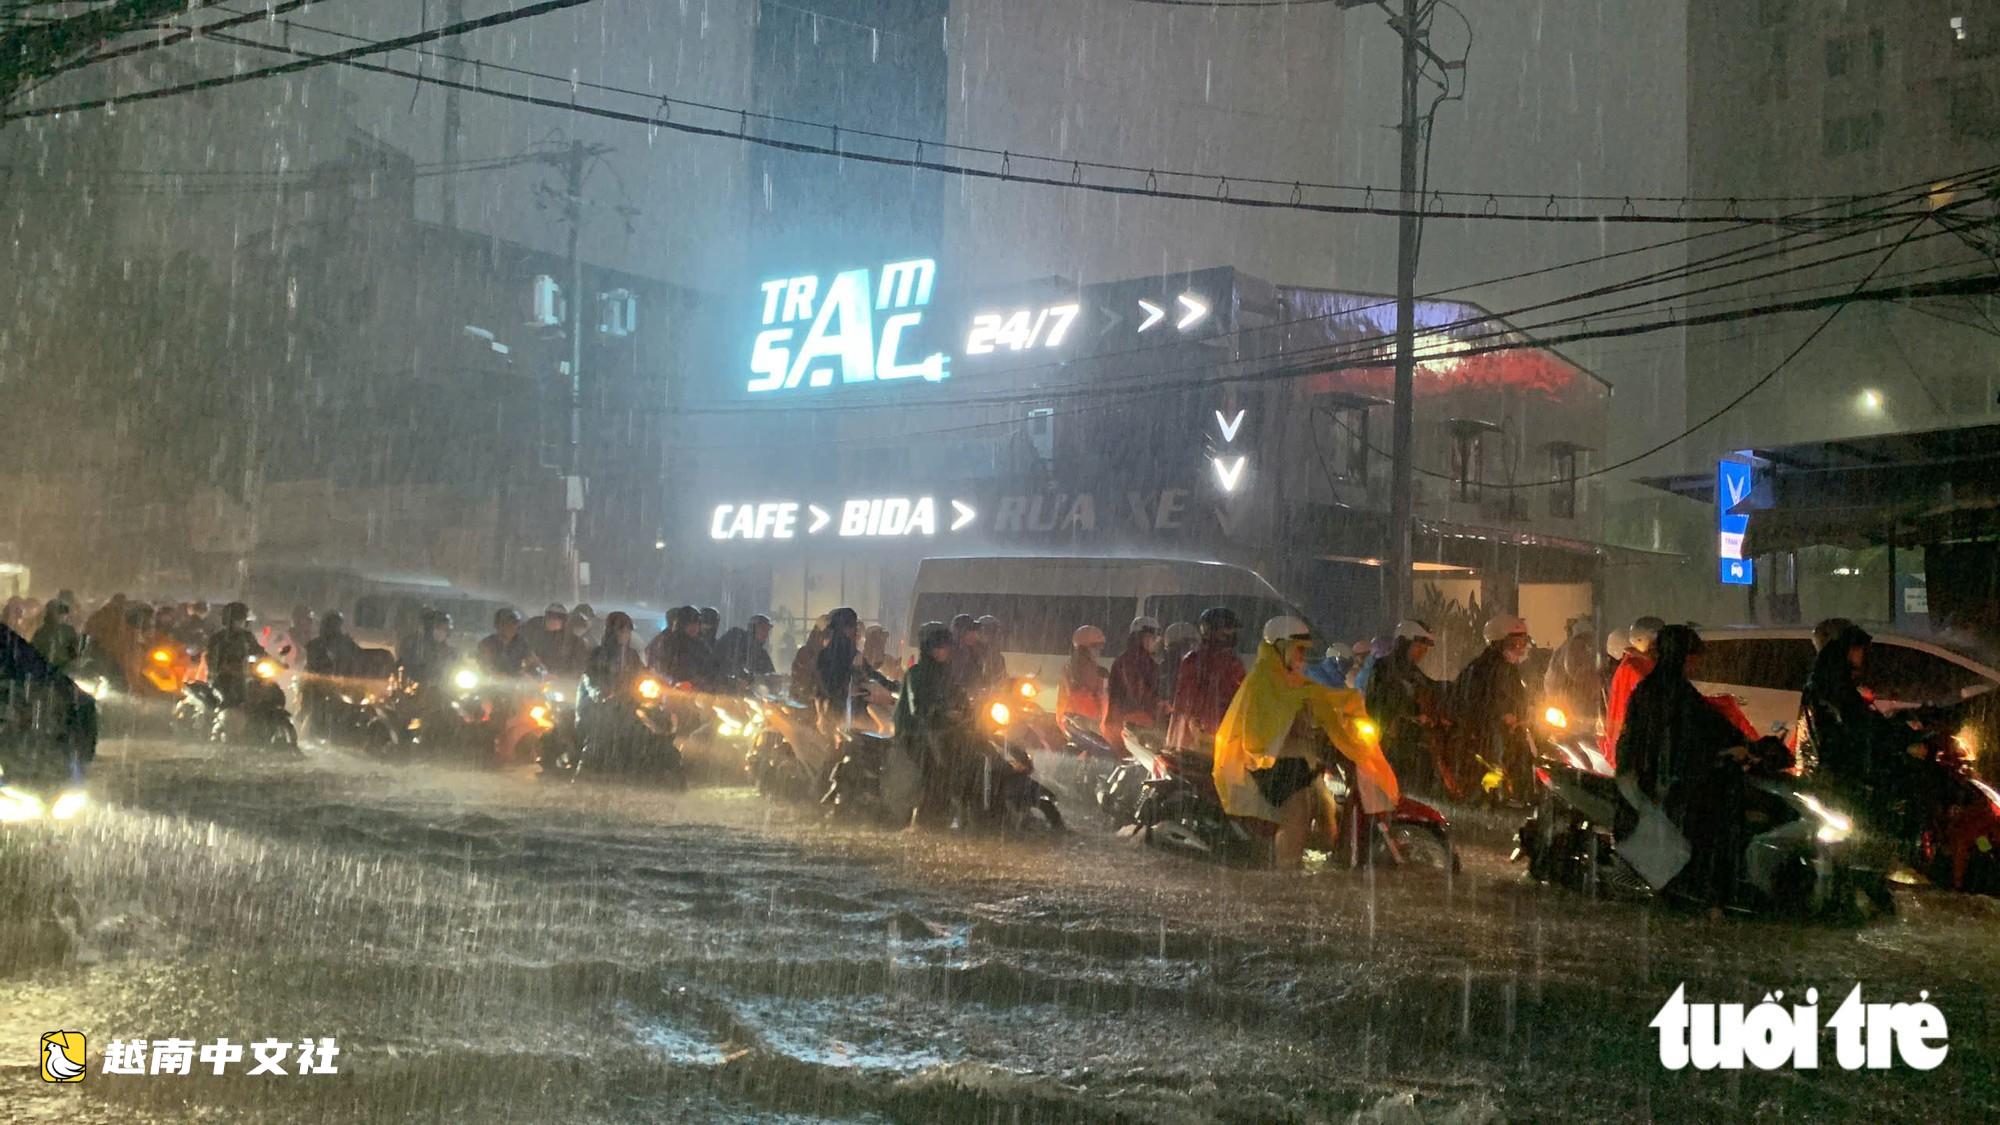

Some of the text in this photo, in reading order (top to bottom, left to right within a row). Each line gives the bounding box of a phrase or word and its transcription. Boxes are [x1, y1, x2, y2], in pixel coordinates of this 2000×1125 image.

[961, 300, 1081, 356] 24/7
[709, 501, 800, 540] CAFE
[838, 496, 936, 537] BIDA
